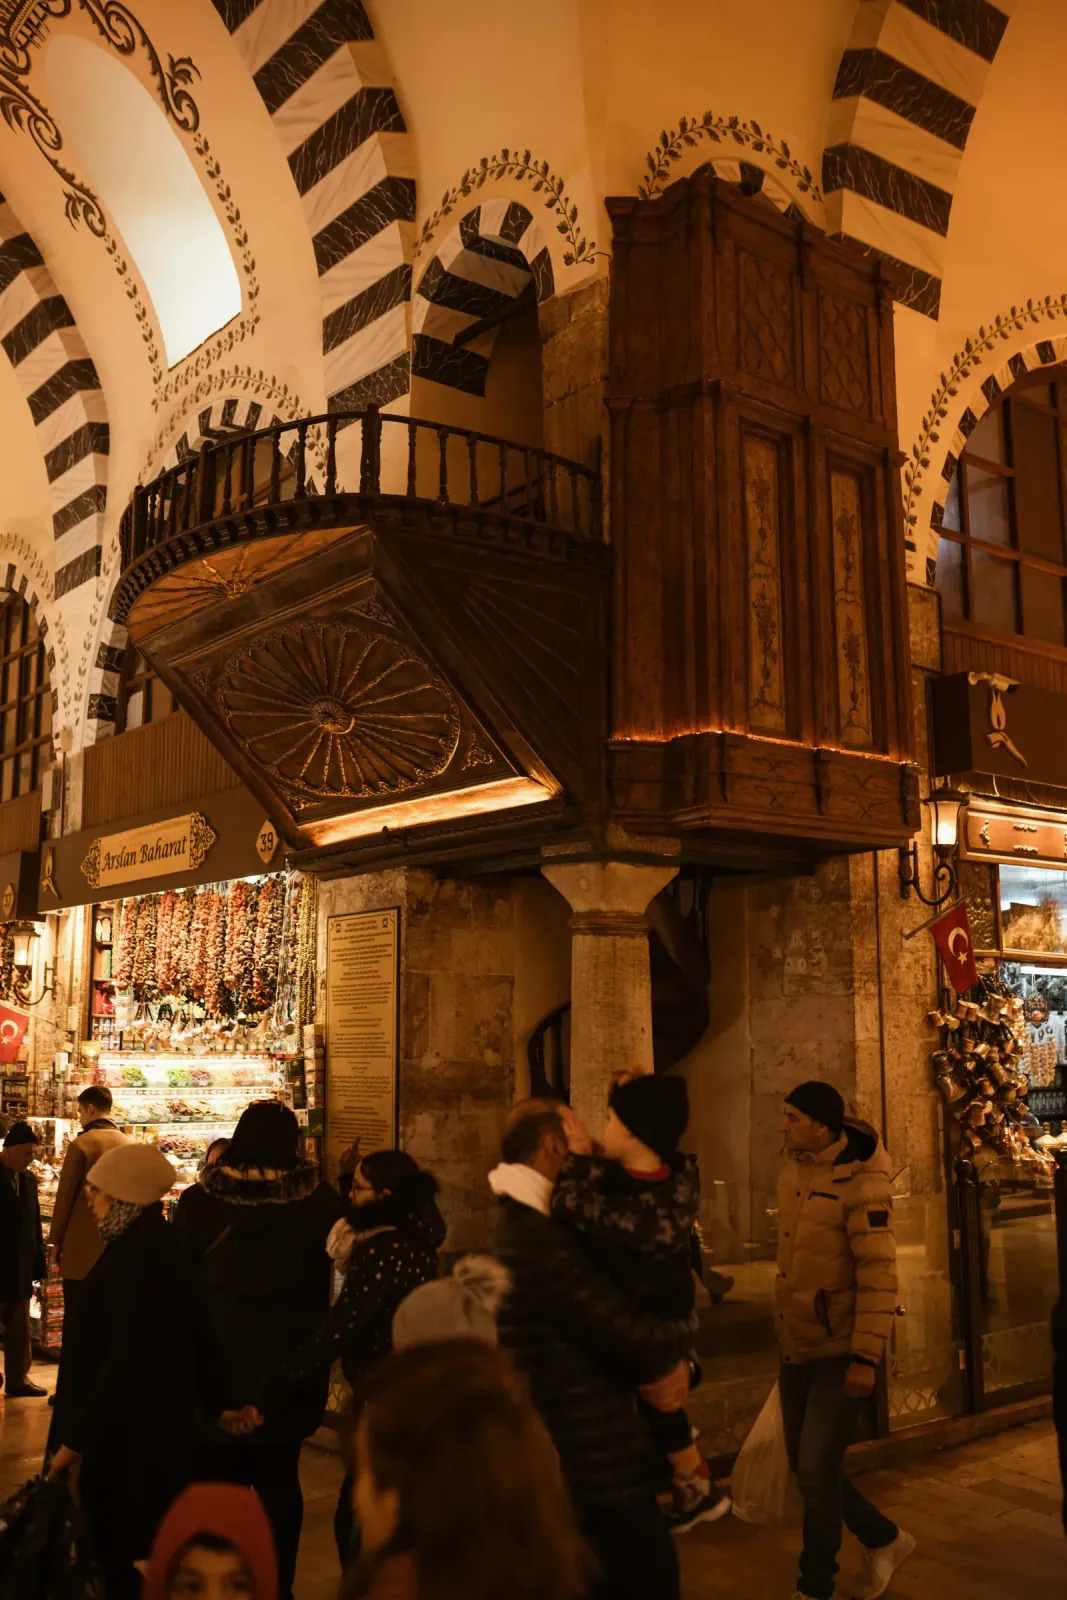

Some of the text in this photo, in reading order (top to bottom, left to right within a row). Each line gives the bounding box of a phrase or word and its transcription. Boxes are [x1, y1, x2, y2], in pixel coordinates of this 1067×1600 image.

[101, 835, 187, 872] Arslan Baharat
[260, 832, 274, 852] 39
